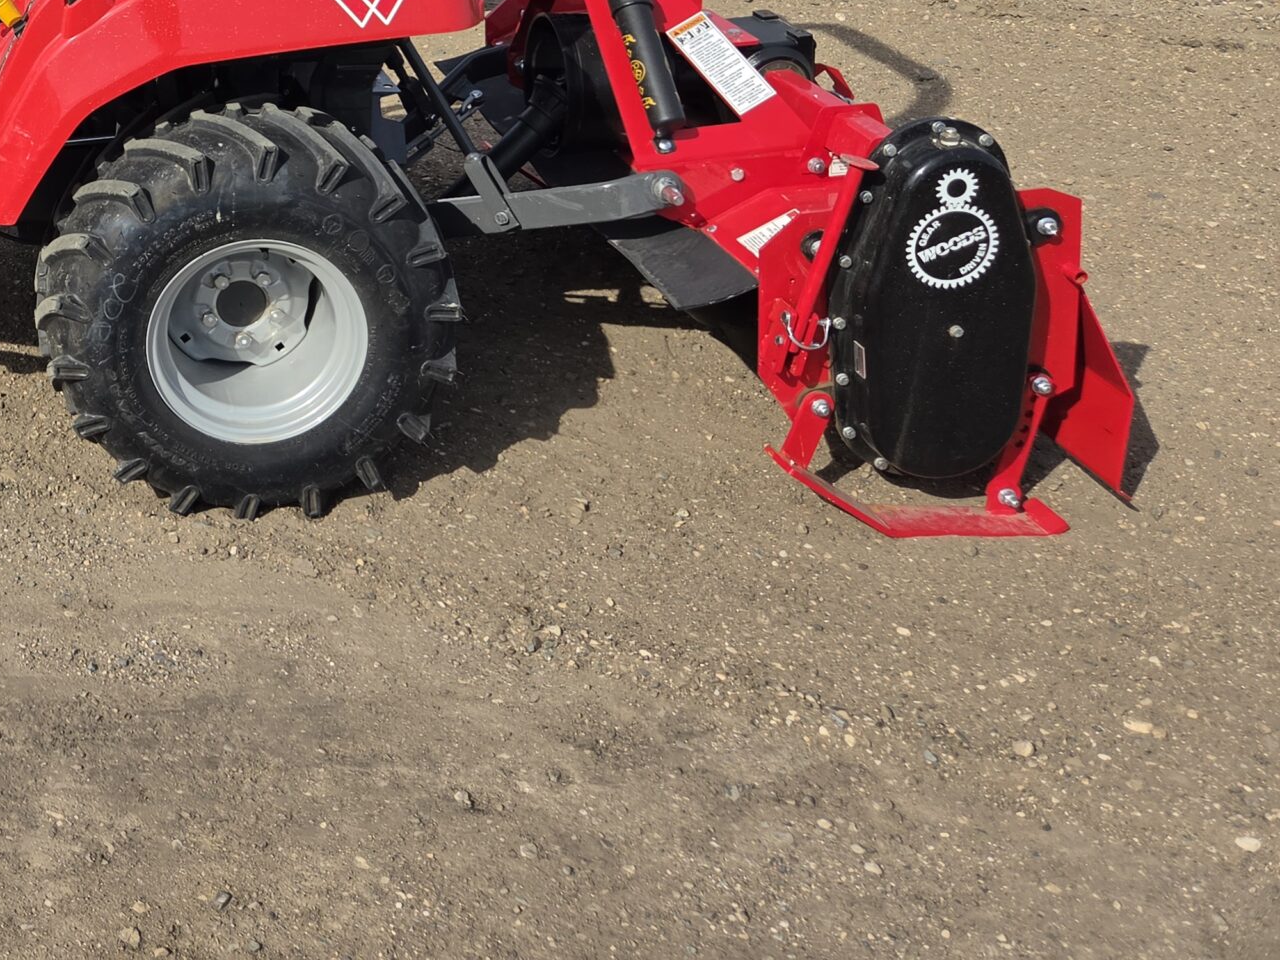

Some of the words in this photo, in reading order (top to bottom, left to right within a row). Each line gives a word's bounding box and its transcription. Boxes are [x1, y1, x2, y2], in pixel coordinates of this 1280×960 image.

[917, 225, 988, 264] WOODS
[918, 220, 941, 247] GEAR
[959, 243, 987, 275] DRIVEN
